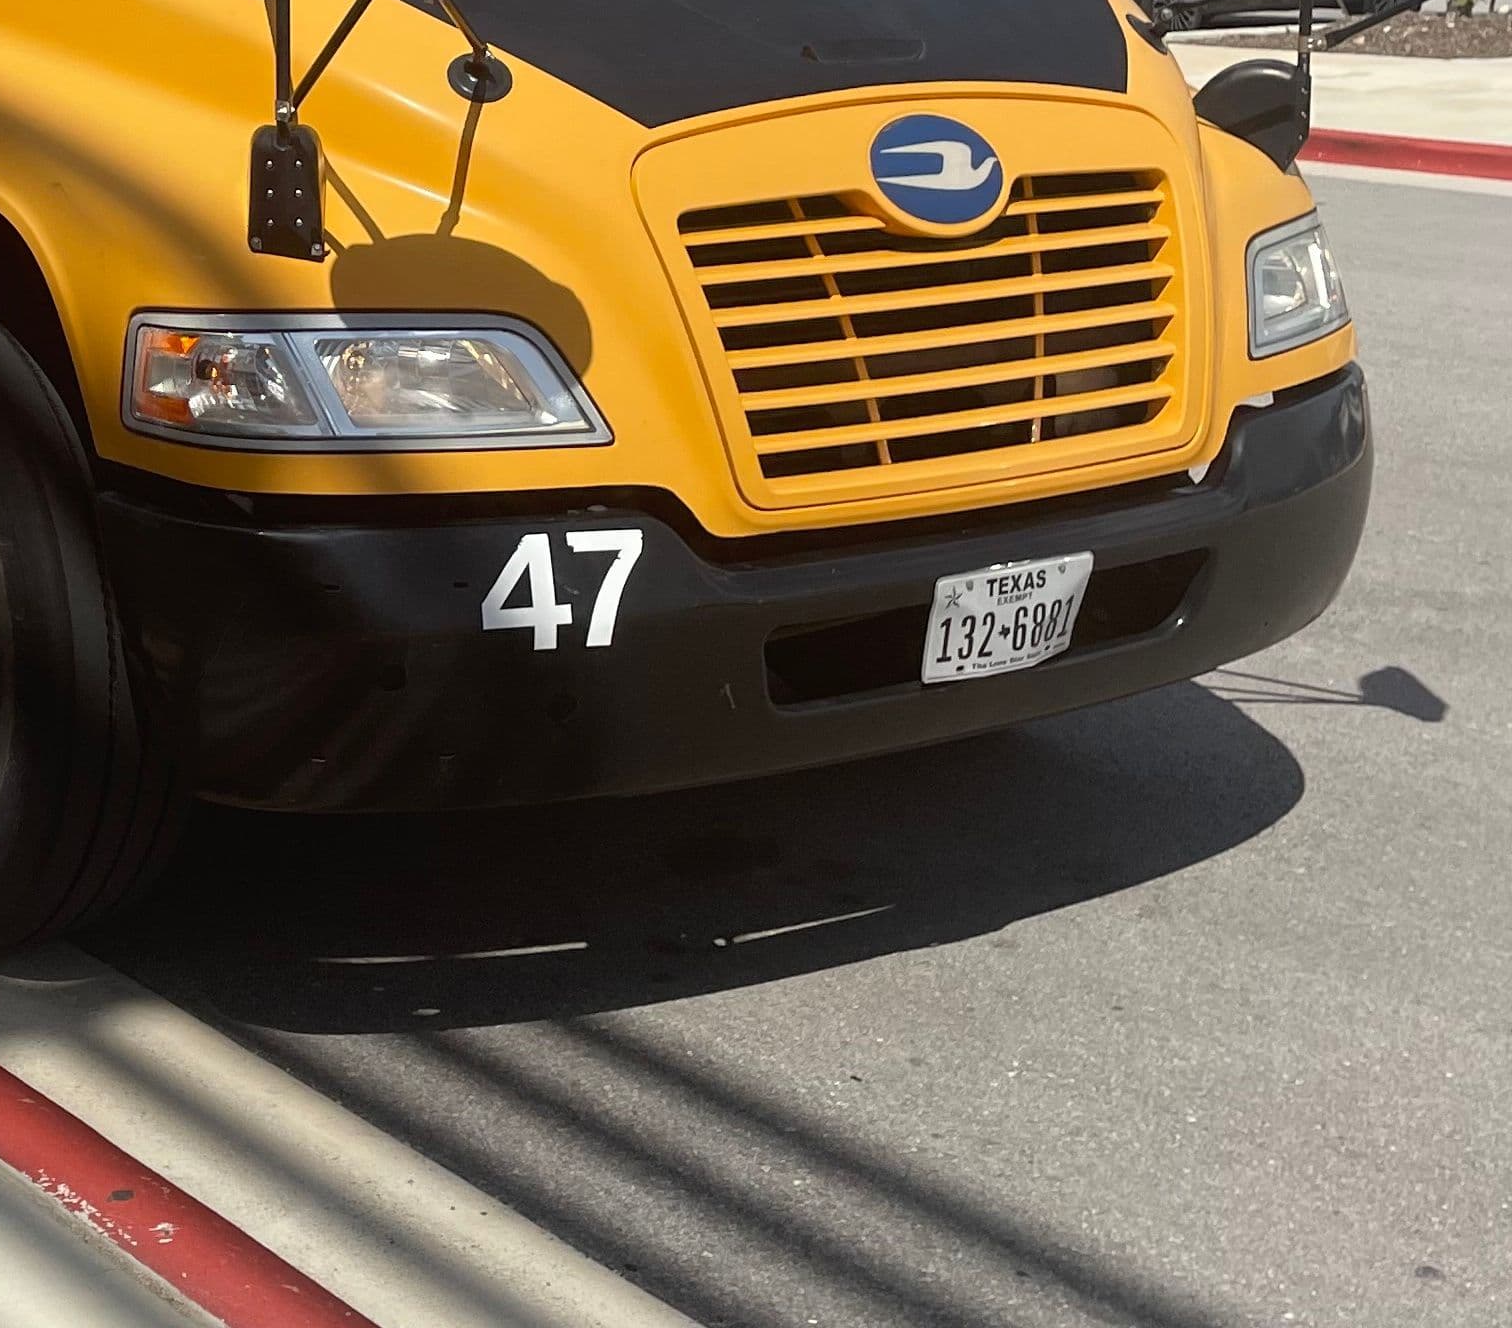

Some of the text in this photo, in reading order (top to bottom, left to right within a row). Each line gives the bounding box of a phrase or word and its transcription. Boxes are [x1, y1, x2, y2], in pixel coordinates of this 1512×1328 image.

[481, 529, 643, 651] 47
[986, 569, 1047, 597] TEXAS
[997, 592, 1033, 606] EXEMPT
